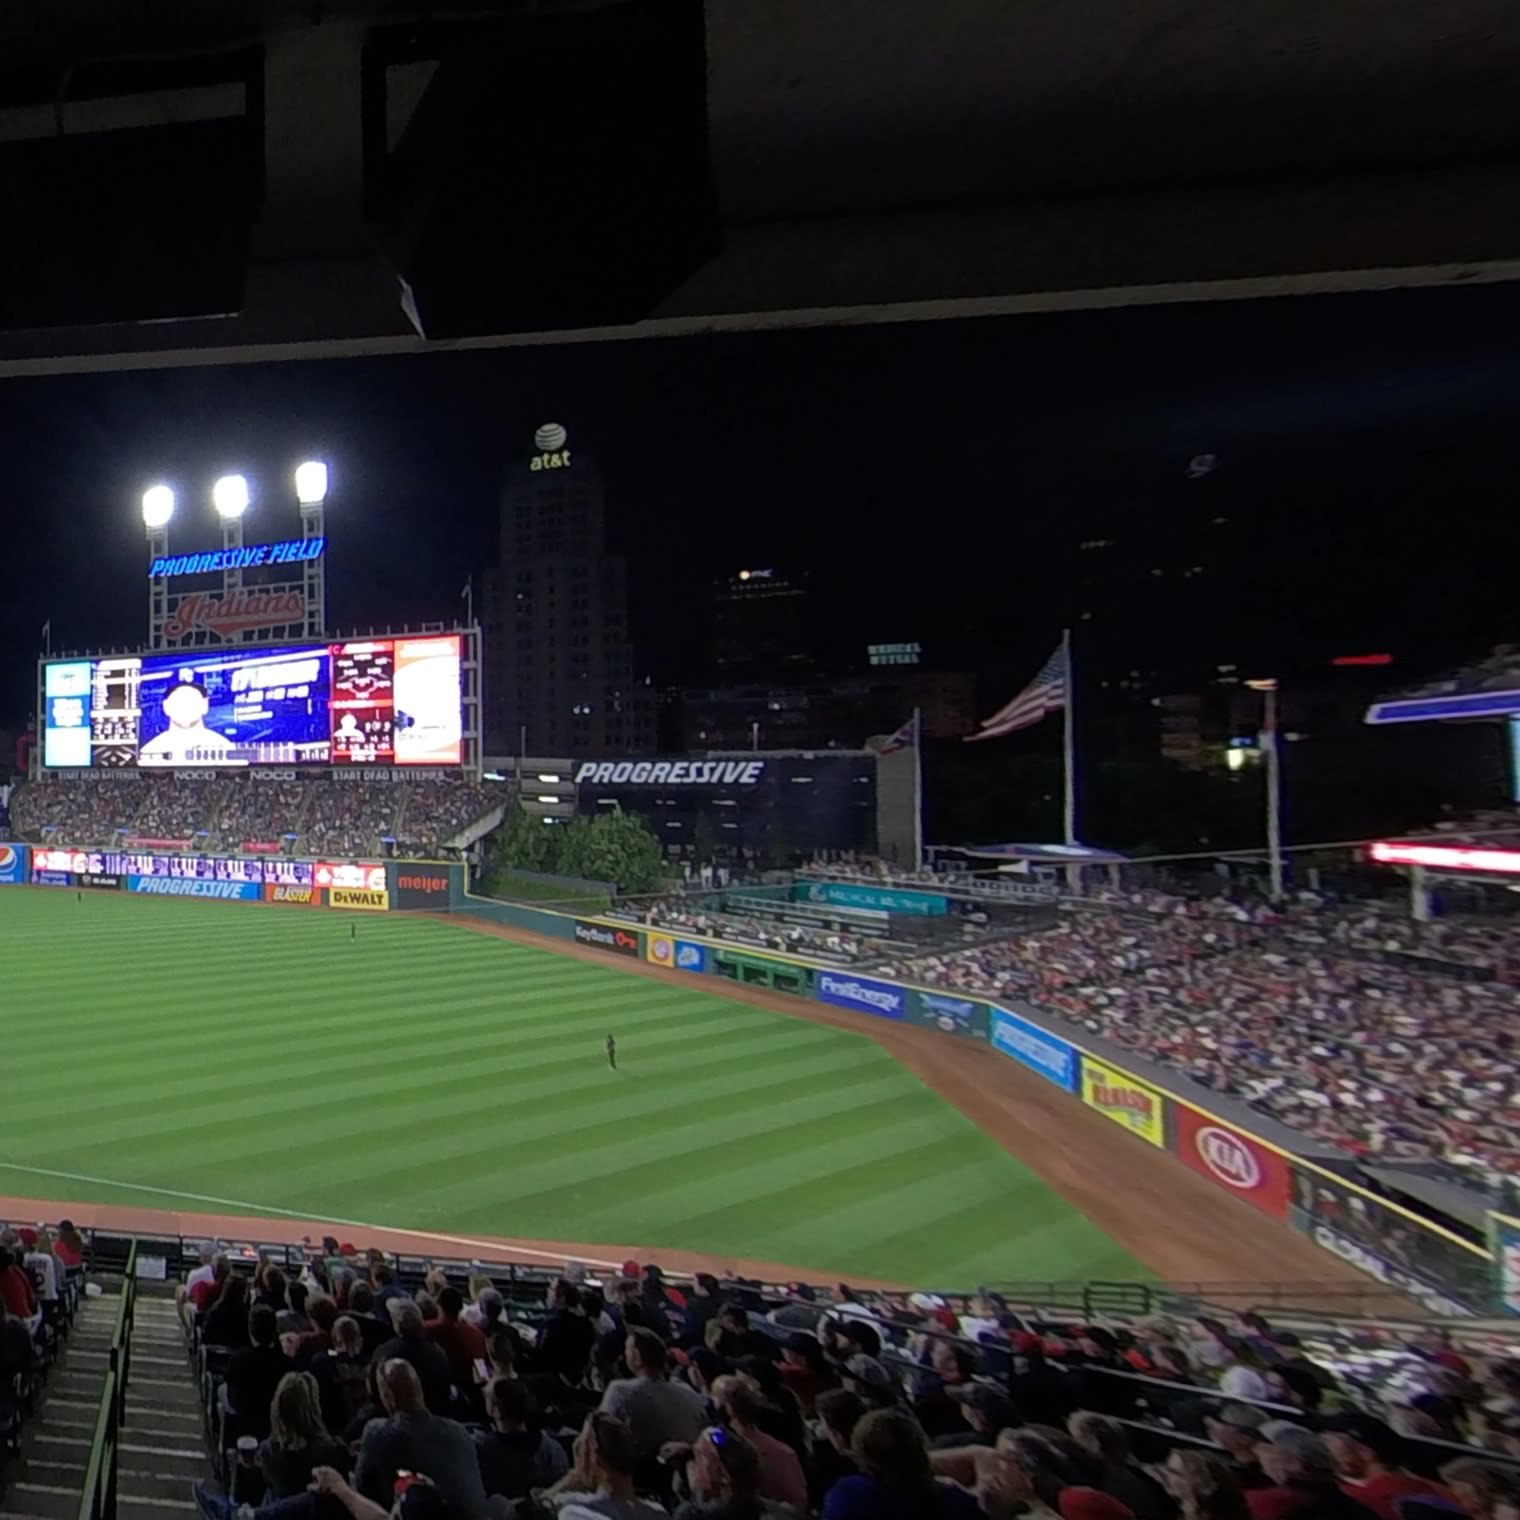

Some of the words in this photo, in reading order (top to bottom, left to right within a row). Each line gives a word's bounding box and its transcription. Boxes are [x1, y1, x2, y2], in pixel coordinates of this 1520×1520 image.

[530, 450, 570, 470] at&t
[149, 546, 269, 577] PROGRESSIVE
[266, 538, 324, 564] FIELD
[163, 588, 306, 639] Indians
[174, 771, 216, 780] NOCO
[249, 770, 296, 780] NOCO
[574, 761, 764, 783] PROGRESSIVE
[136, 877, 245, 899] PROGRESSIVE
[398, 875, 449, 893] meijer
[821, 976, 903, 1012] FirstEnergy
